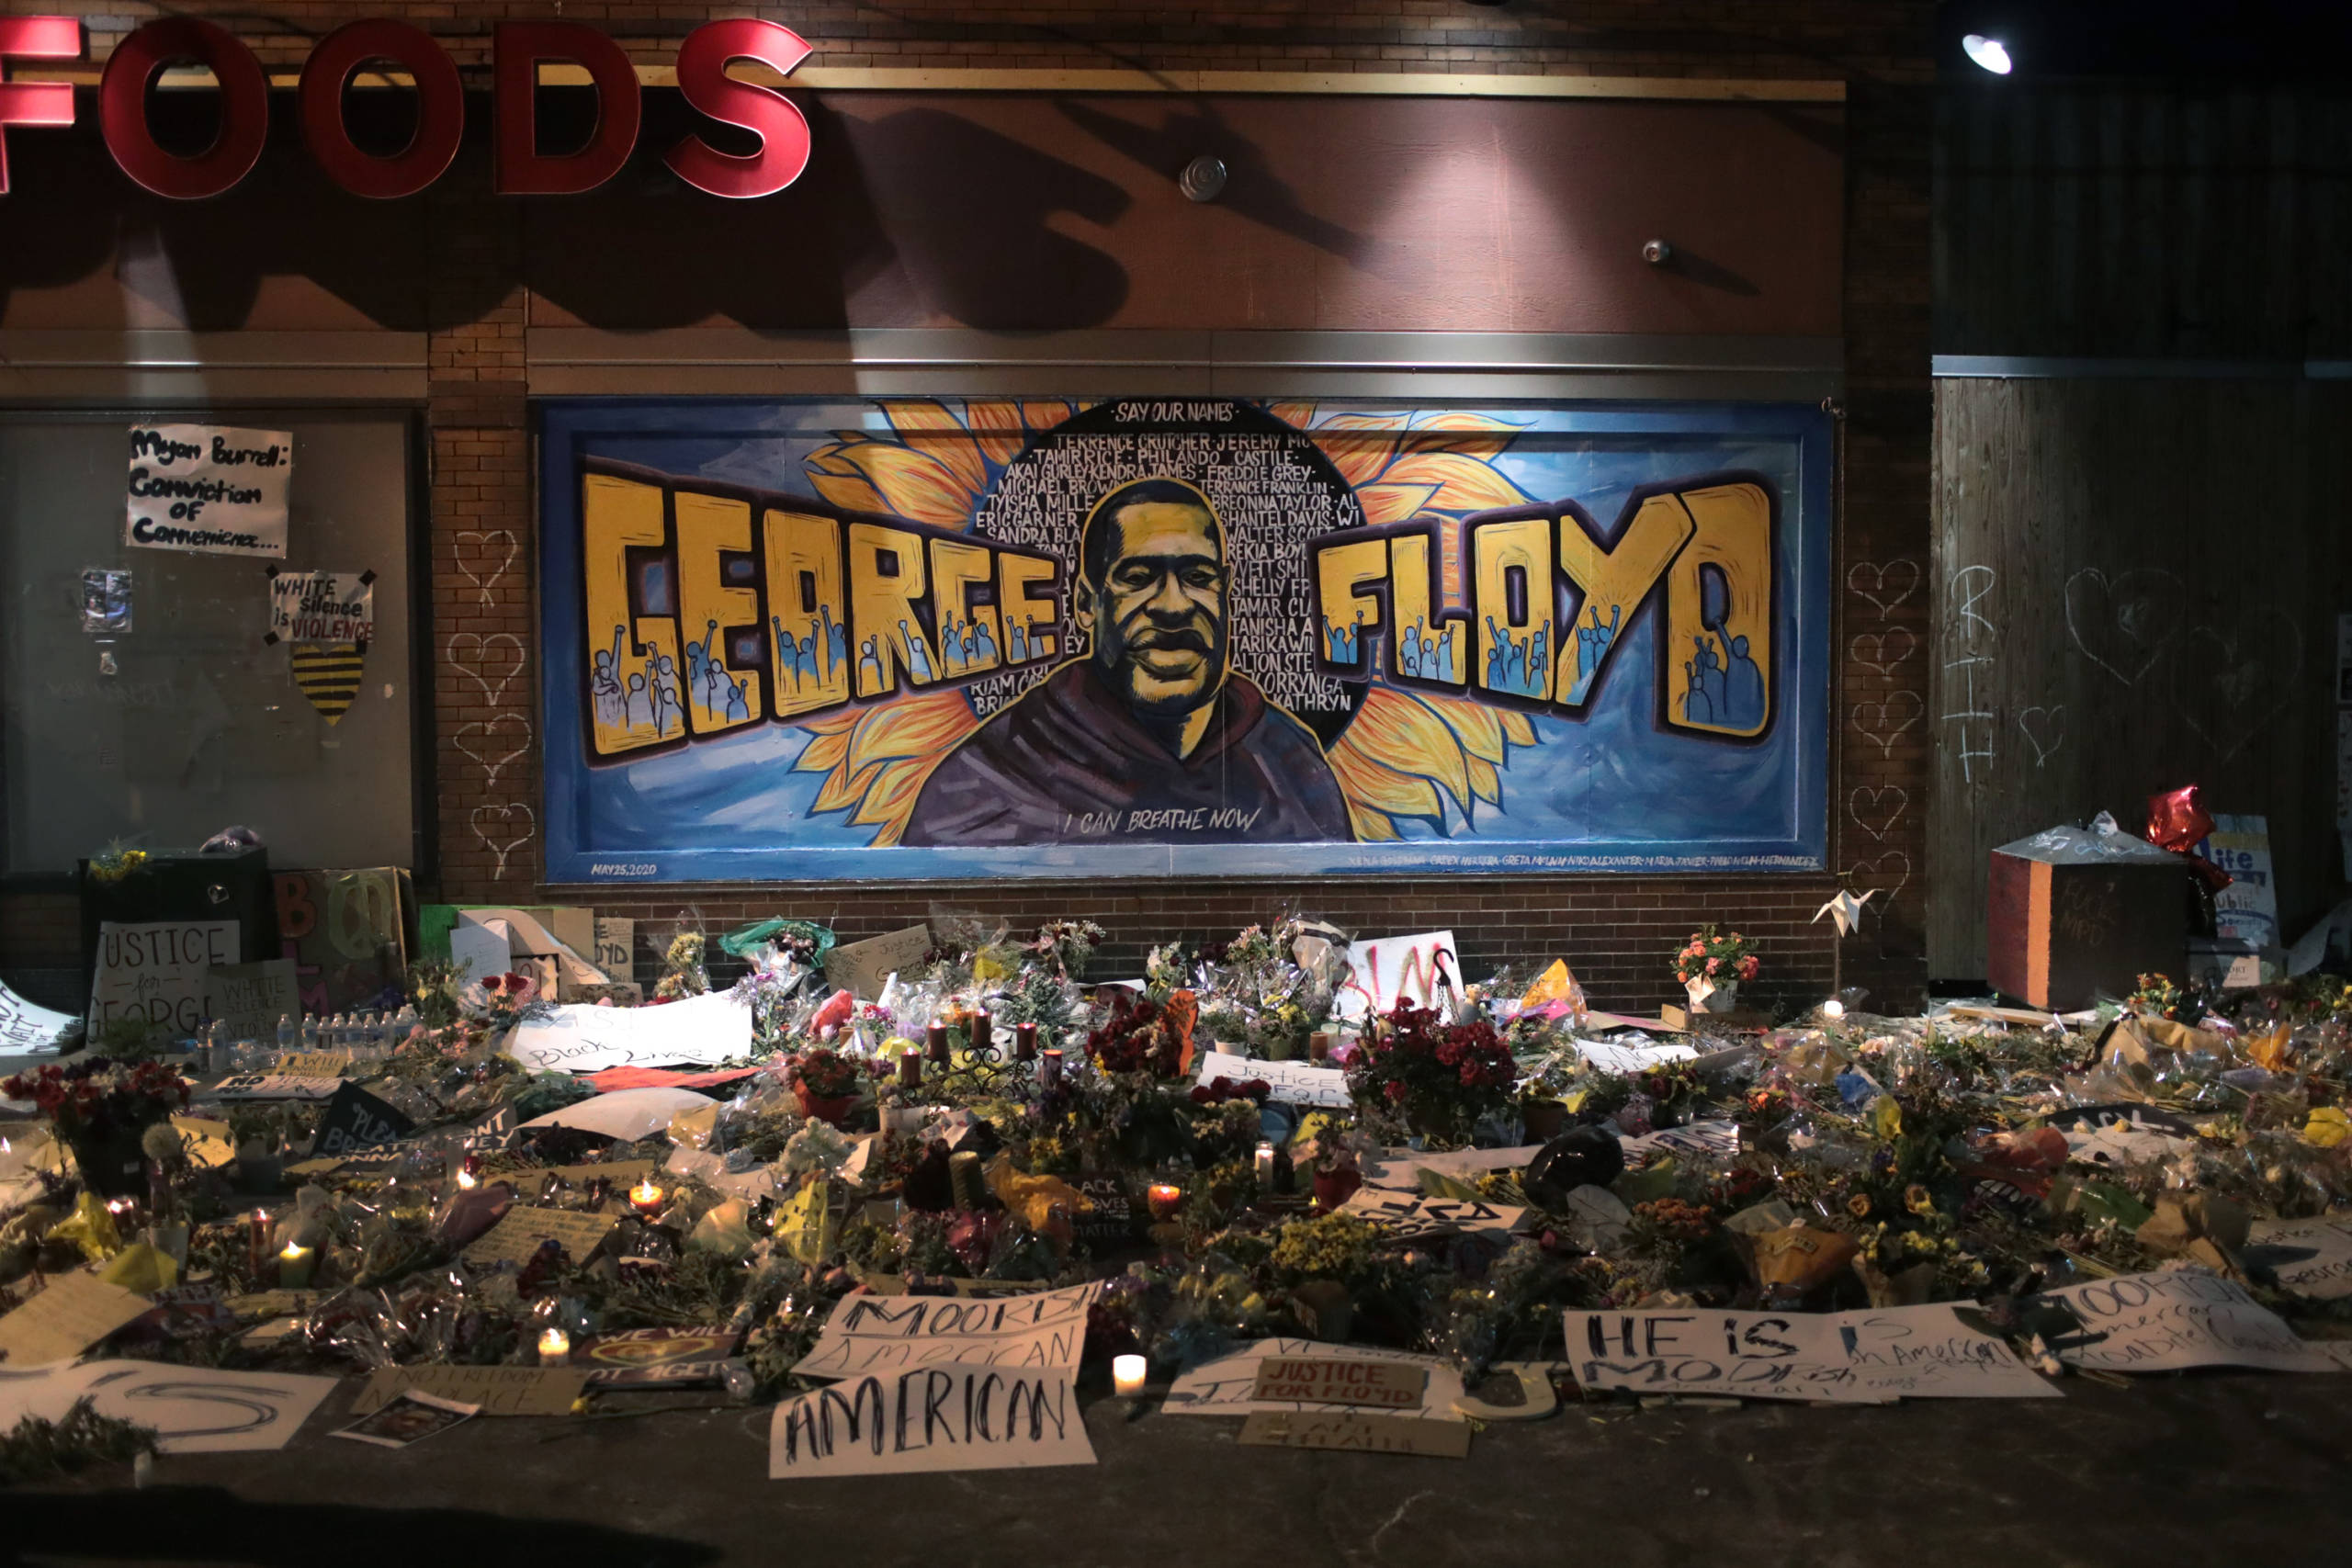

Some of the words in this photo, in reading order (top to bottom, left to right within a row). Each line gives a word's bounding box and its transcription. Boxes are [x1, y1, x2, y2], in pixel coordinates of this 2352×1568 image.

[0, 16, 813, 199] FOODS
[1115, 402, 1148, 423] SAY
[1152, 402, 1185, 423] OUR
[1187, 403, 1234, 423] NAMES
[1054, 434, 1135, 450] TERRENCE
[1138, 434, 1211, 450] CRUTCHER
[1216, 434, 1281, 451] JEREMY
[1034, 449, 1081, 465] TAMIR
[1084, 449, 1123, 465] RICE
[1138, 450, 1220, 466] PHILANDO
[1234, 450, 1294, 467] CASTILE
[1005, 463, 1038, 479] AKAI
[1041, 464, 1090, 479] GURLEY
[1090, 464, 1145, 479] KENDRA
[1148, 465, 1196, 479] JAMES
[1207, 465, 1269, 480] FREDDIE
[1272, 466, 1312, 482] GREY
[130, 468, 262, 503] Conviction
[998, 479, 1065, 496] MICHAEL
[1200, 479, 1260, 494] TERRANCE
[1262, 480, 1329, 495] FRANKLIN
[988, 494, 1040, 513] TYISHA
[1212, 494, 1282, 511] BREONNA
[1281, 494, 1333, 512] TAYLOR
[1338, 493, 1359, 511] AL
[976, 511, 1011, 528] ERIC
[1012, 511, 1080, 528] GARNER
[1219, 511, 1286, 527] SHANTEL
[1287, 511, 1330, 527] DAVIS
[987, 527, 1049, 545] SANDRA
[1224, 527, 1286, 544] WALTER
[1227, 543, 1270, 560] REKIA
[274, 579, 337, 596] WHITE
[1231, 578, 1285, 597] SHELLY
[300, 594, 363, 617] silence
[582, 470, 1058, 757] GEORGE
[1317, 481, 1771, 739] FLOYD
[1228, 598, 1284, 618] JAMAR
[291, 618, 375, 641] VIOLENCE
[1230, 617, 1297, 637] TANISHA
[1230, 636, 1287, 653] TARIKA
[1231, 653, 1282, 673] ALTON
[1273, 694, 1351, 712] KATHRYN
[1063, 813, 1072, 833] I
[1080, 809, 1123, 834] CAN
[1125, 807, 1208, 833] BREATHE
[1208, 807, 1262, 832] NOW
[527, 1038, 618, 1067] Black
[1587, 1314, 1696, 1359] HE
[1269, 1361, 1386, 1385] JUSTICE
[1259, 1383, 1315, 1399] FOR
[1322, 1384, 1414, 1404] FLOYD
[785, 1365, 1065, 1466] AMERICAN
